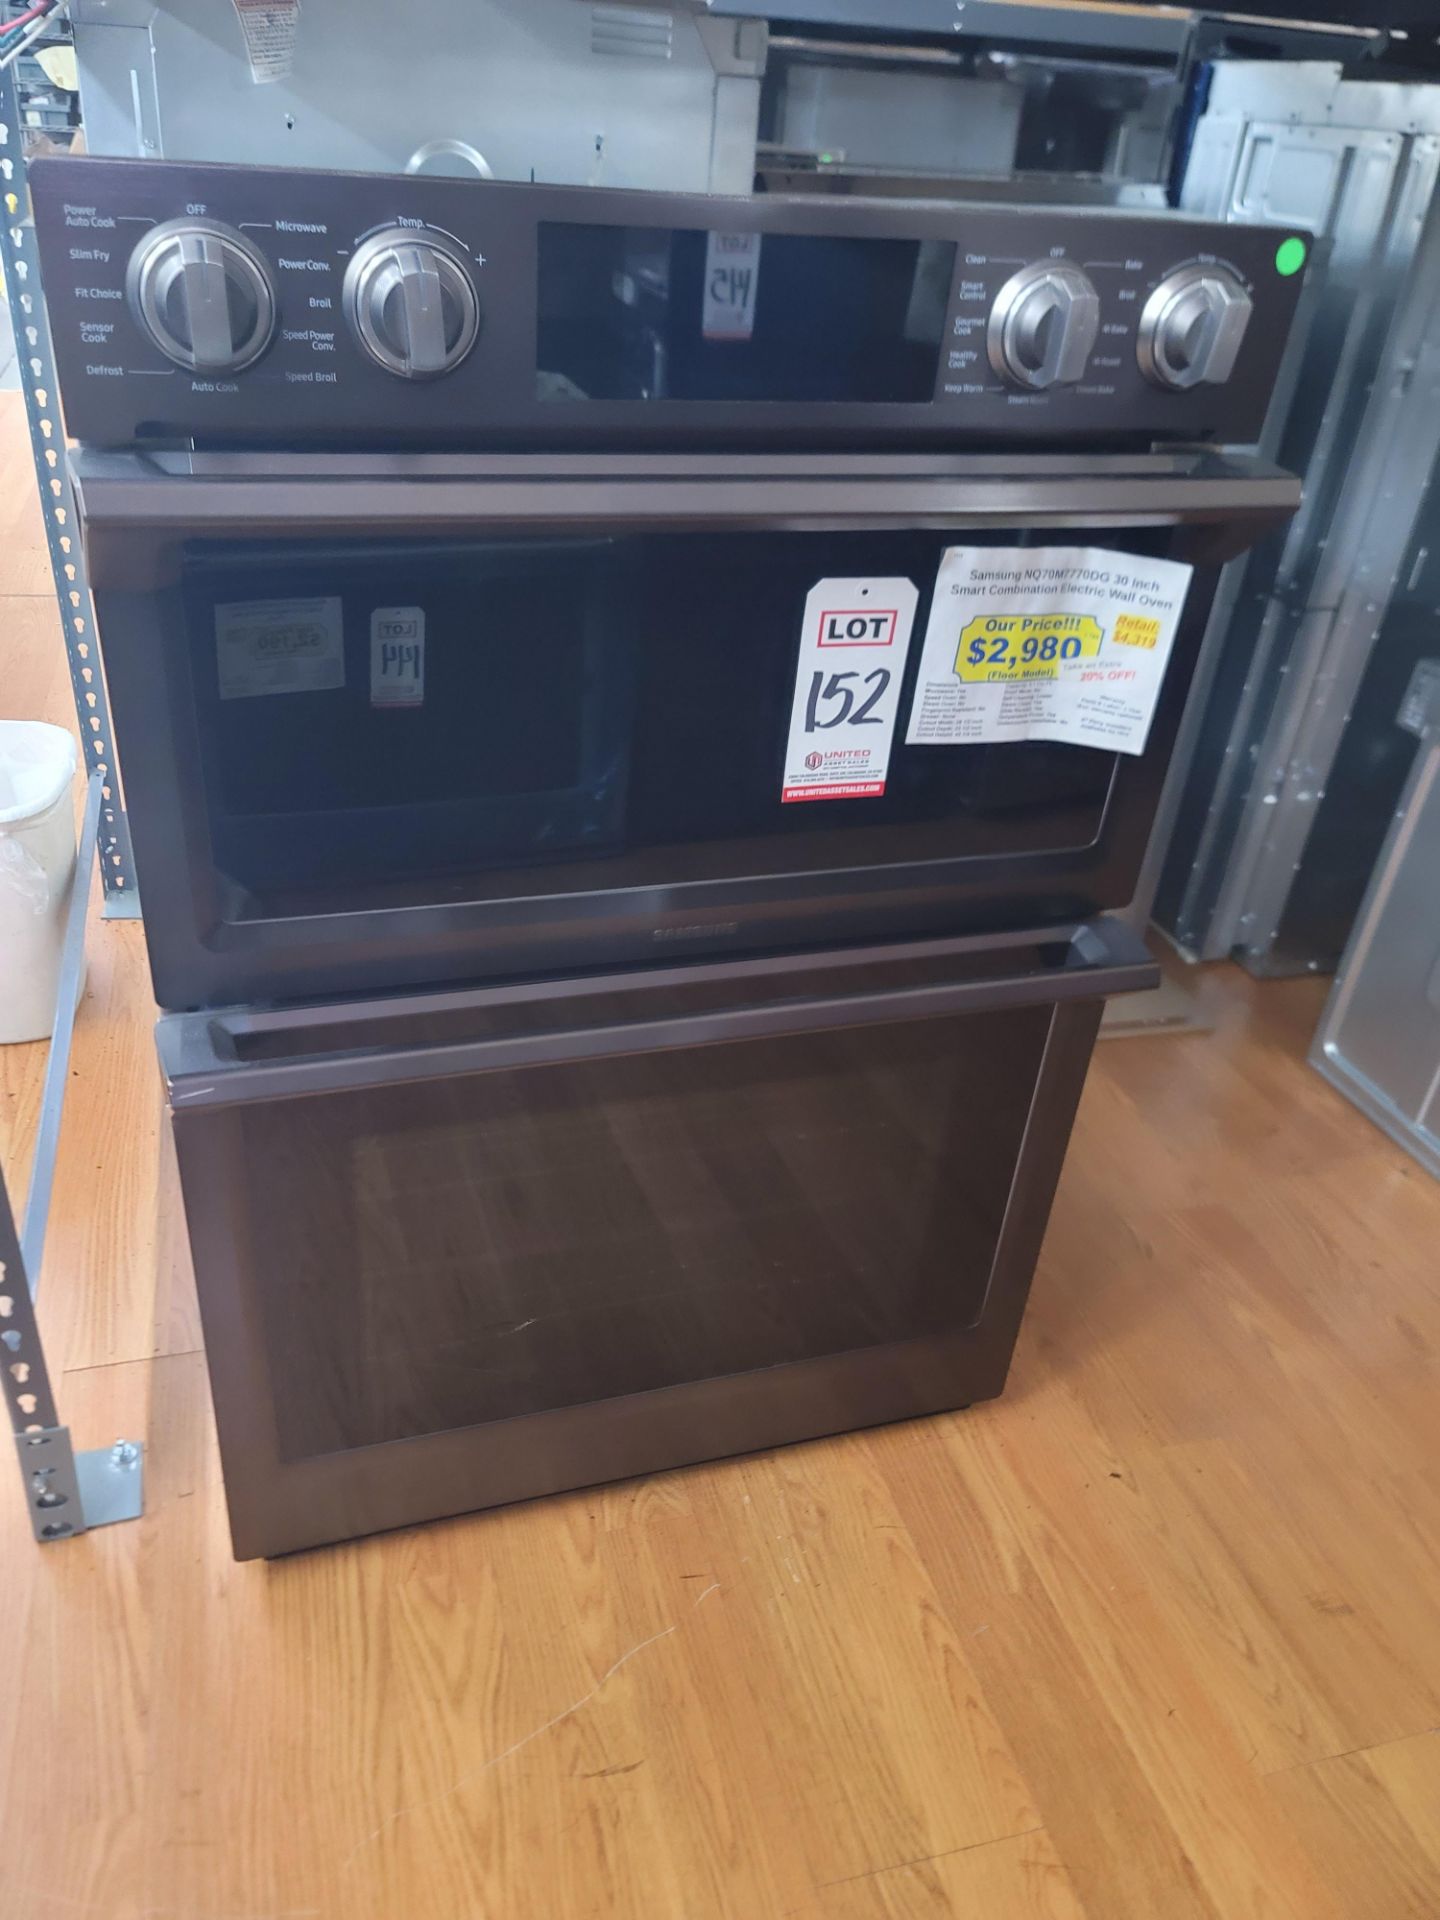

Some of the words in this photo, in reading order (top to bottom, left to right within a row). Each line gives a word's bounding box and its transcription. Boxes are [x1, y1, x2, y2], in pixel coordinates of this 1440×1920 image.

[64, 204, 97, 216] Power
[186, 203, 207, 215] OFF
[65, 215, 90, 227] Auto
[91, 216, 116, 228] Cook
[275, 220, 328, 234] Microwave
[397, 215, 425, 229] Temp.
[69, 248, 93, 260] Slim
[94, 249, 110, 263] Fry
[965, 254, 987, 265] Clean
[278, 258, 306, 270] Power
[306, 261, 331, 272] Conv.
[75, 287, 89, 299] Fit
[90, 288, 122, 300] Choice
[308, 297, 332, 309] Broil
[79, 321, 114, 333] Sensor
[81, 332, 108, 344] Cook
[282, 330, 309, 341] Speed
[309, 331, 334, 341] Power
[312, 341, 336, 352] Conv.
[86, 364, 125, 377] Defrost
[285, 371, 313, 384] Speed
[315, 372, 337, 383] Broil
[191, 381, 215, 392] Auto
[215, 382, 239, 393] Cook
[969, 569, 1022, 583] Samsung
[1113, 574, 1129, 586] 30
[1131, 577, 1160, 592] Inch
[950, 584, 987, 596] Smart
[988, 584, 1058, 596] Combination
[1060, 583, 1107, 598] Electric
[1109, 589, 1136, 603] Wall
[1138, 595, 1174, 610] Oven
[827, 617, 889, 640] LOT
[985, 619, 1017, 633] Our
[1021, 617, 1081, 632] Price!!!
[966, 635, 1082, 671] $2,980
[987, 669, 1018, 681] (Floor
[1021, 668, 1055, 680] Model)
[804, 668, 891, 733] 152
[823, 750, 872, 760] UNITED
